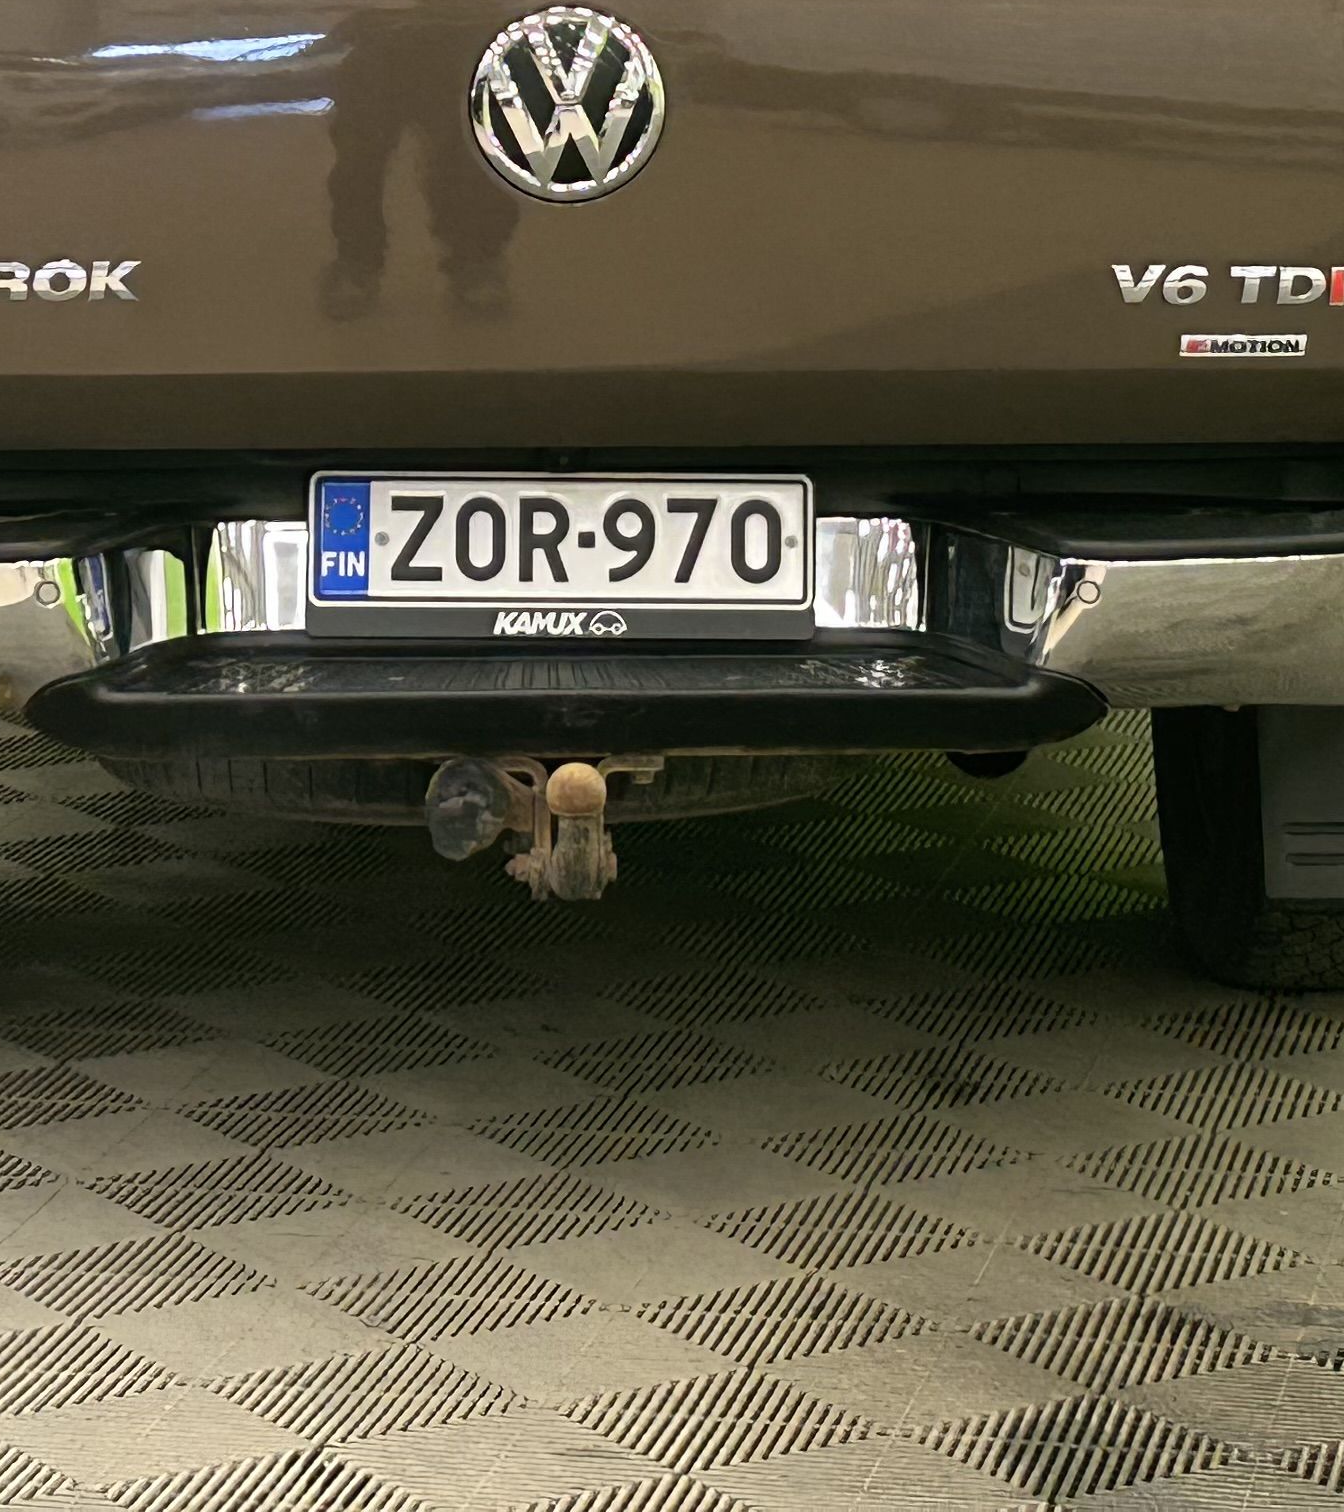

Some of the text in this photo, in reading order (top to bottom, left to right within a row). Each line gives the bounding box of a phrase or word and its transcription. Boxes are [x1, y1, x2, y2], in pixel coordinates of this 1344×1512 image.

[1111, 264, 1209, 305] V6
[321, 495, 782, 584] FIN ZOR-970
[493, 611, 586, 635] KAMUX
